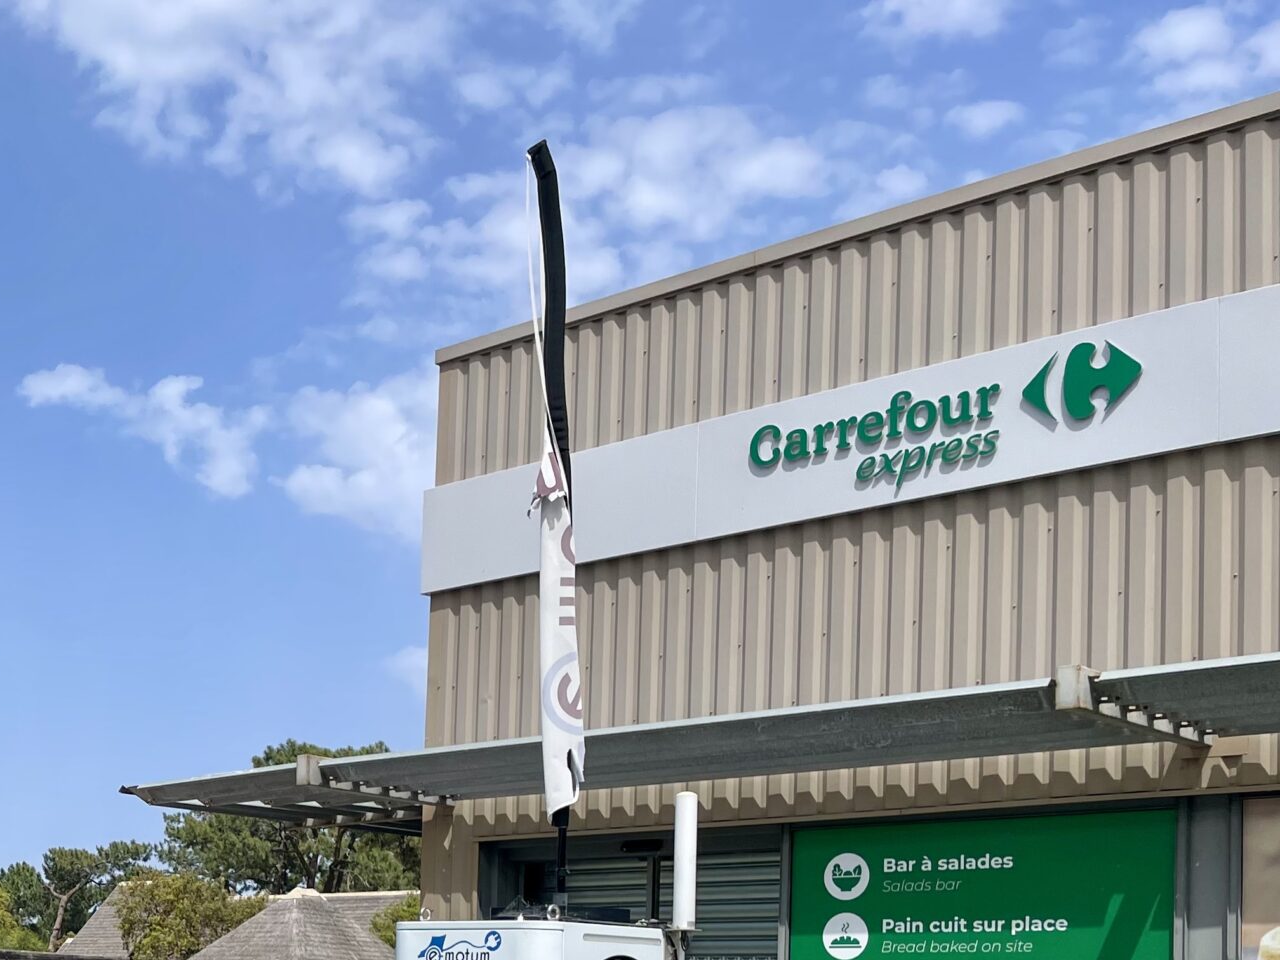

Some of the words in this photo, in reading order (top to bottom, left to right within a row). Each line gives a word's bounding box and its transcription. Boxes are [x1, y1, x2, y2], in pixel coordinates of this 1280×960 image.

[749, 382, 1002, 469] Carrefour
[855, 429, 1001, 489] express
[883, 857, 917, 873] Bar
[921, 855, 932, 871] à
[937, 853, 1014, 870] salades
[882, 879, 932, 893] Salads
[935, 878, 962, 892] bar
[881, 917, 924, 934] Pain
[928, 916, 968, 933] cuit
[972, 918, 1005, 933] sur
[1011, 916, 1069, 935] place
[881, 940, 926, 954] Bread
[929, 940, 979, 953] baked
[981, 942, 1002, 953] on
[1005, 939, 1033, 953] site
